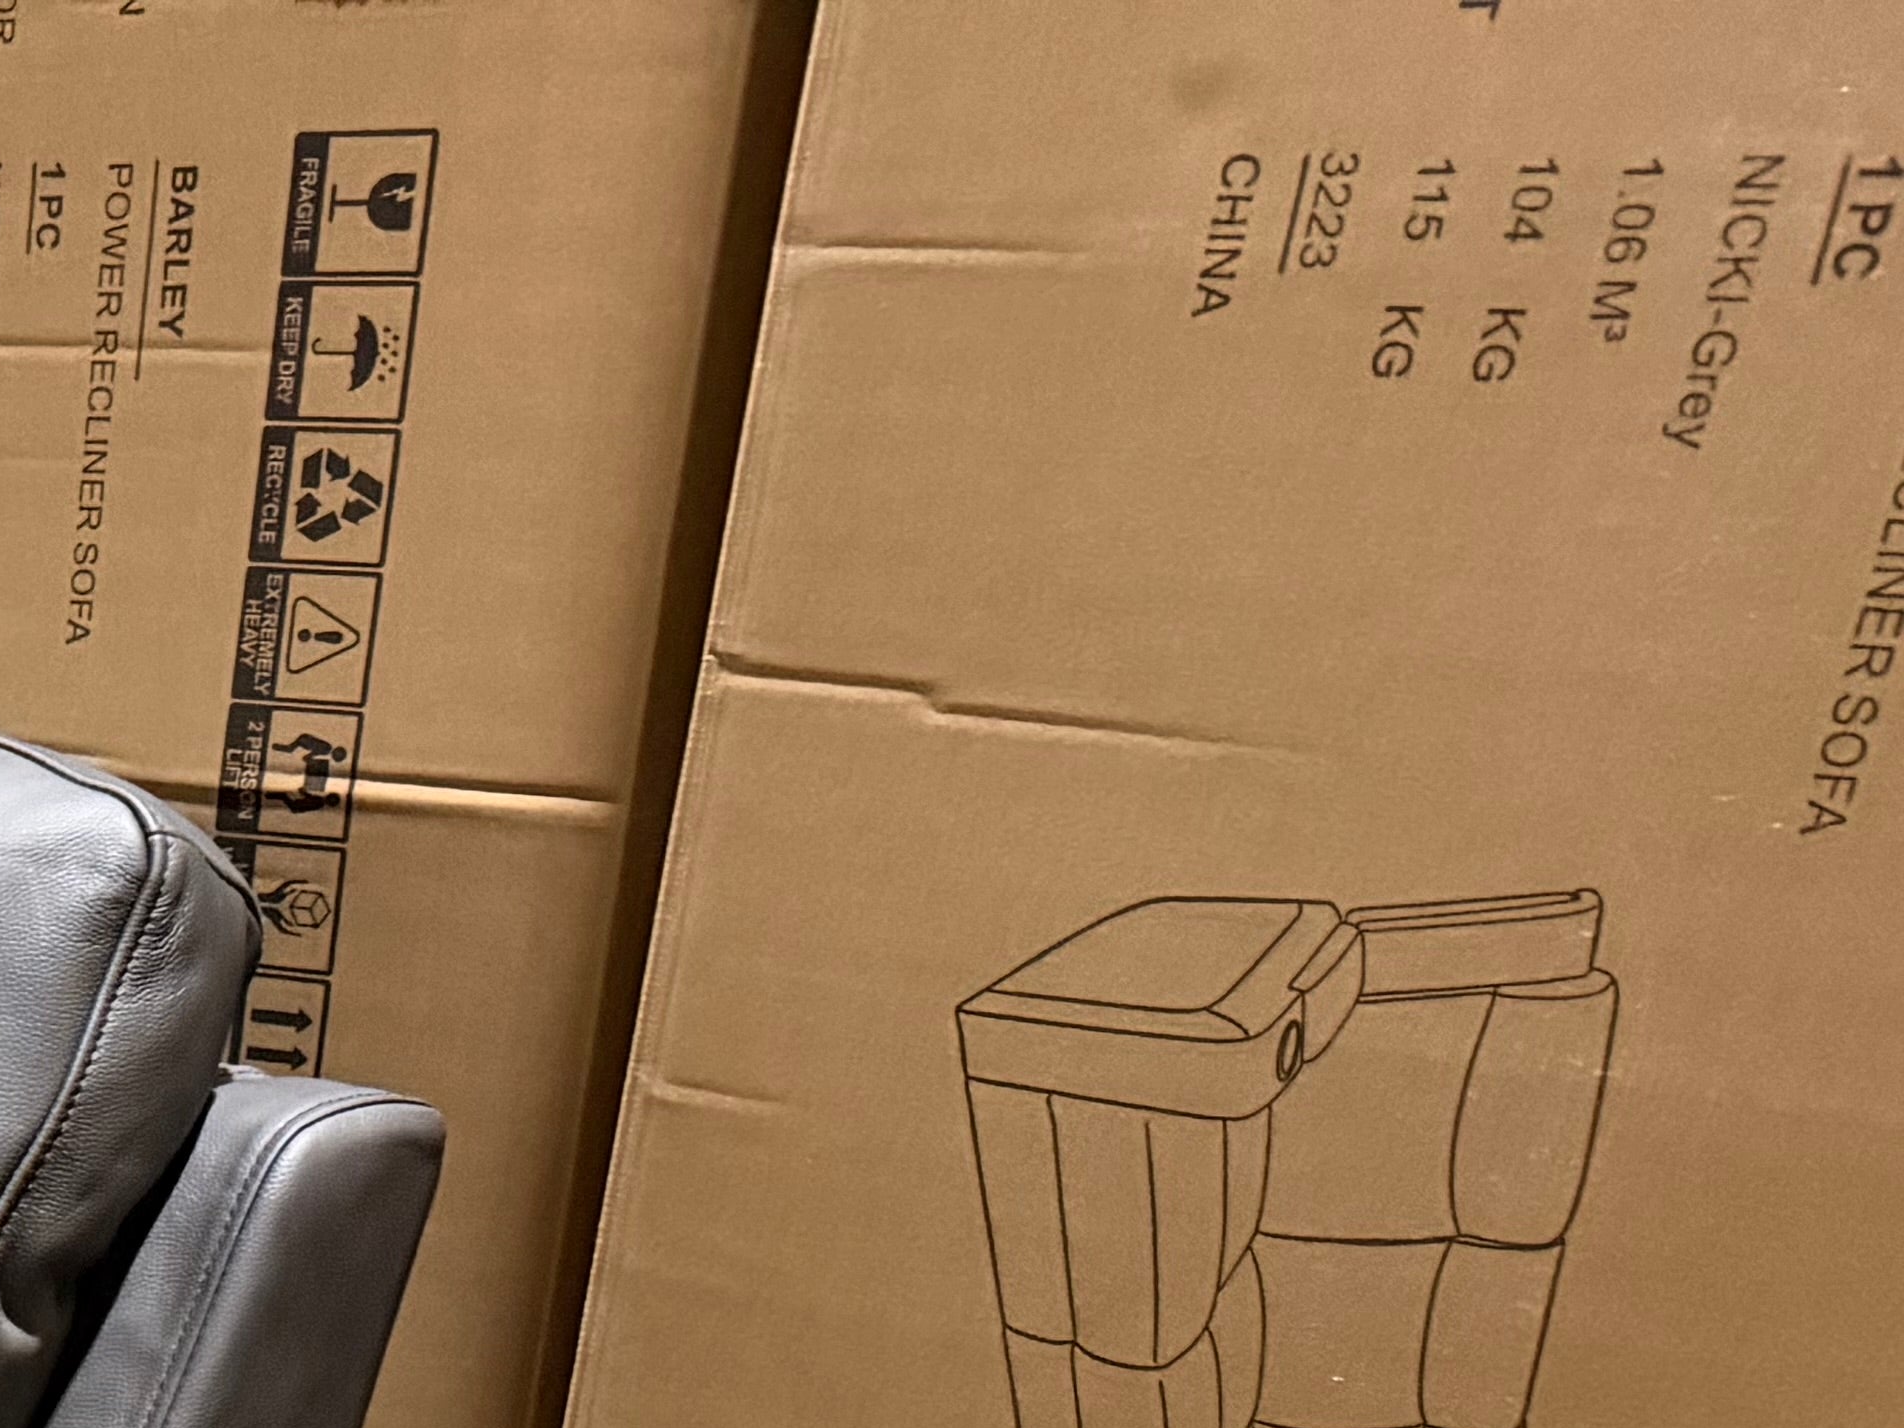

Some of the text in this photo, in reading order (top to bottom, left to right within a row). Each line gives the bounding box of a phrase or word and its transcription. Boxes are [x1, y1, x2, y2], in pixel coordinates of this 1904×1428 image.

[34, 196, 65, 250] PC
[158, 165, 200, 338] BARLEY
[291, 157, 320, 254] FRAGILE
[1191, 152, 1262, 318] CHINA
[1299, 151, 1361, 270] 3223
[1603, 157, 1665, 265] 1.06
[1833, 203, 1894, 279] PC
[1371, 158, 1457, 379] 115 KG
[1473, 157, 1560, 383] 104 KG
[1662, 154, 1787, 451] NICKI-Grey
[65, 163, 134, 645] POWER RECLINER SOFA
[276, 297, 303, 404] KEEP DRY
[257, 444, 287, 545] RECYCLE
[240, 598, 264, 667] HEAVY
[252, 573, 285, 697] EXTREMELY
[223, 747, 245, 792] LIFT
[237, 737, 264, 821] PERSON
[246, 720, 266, 734] 2
[1799, 693, 1880, 836] SOFA
